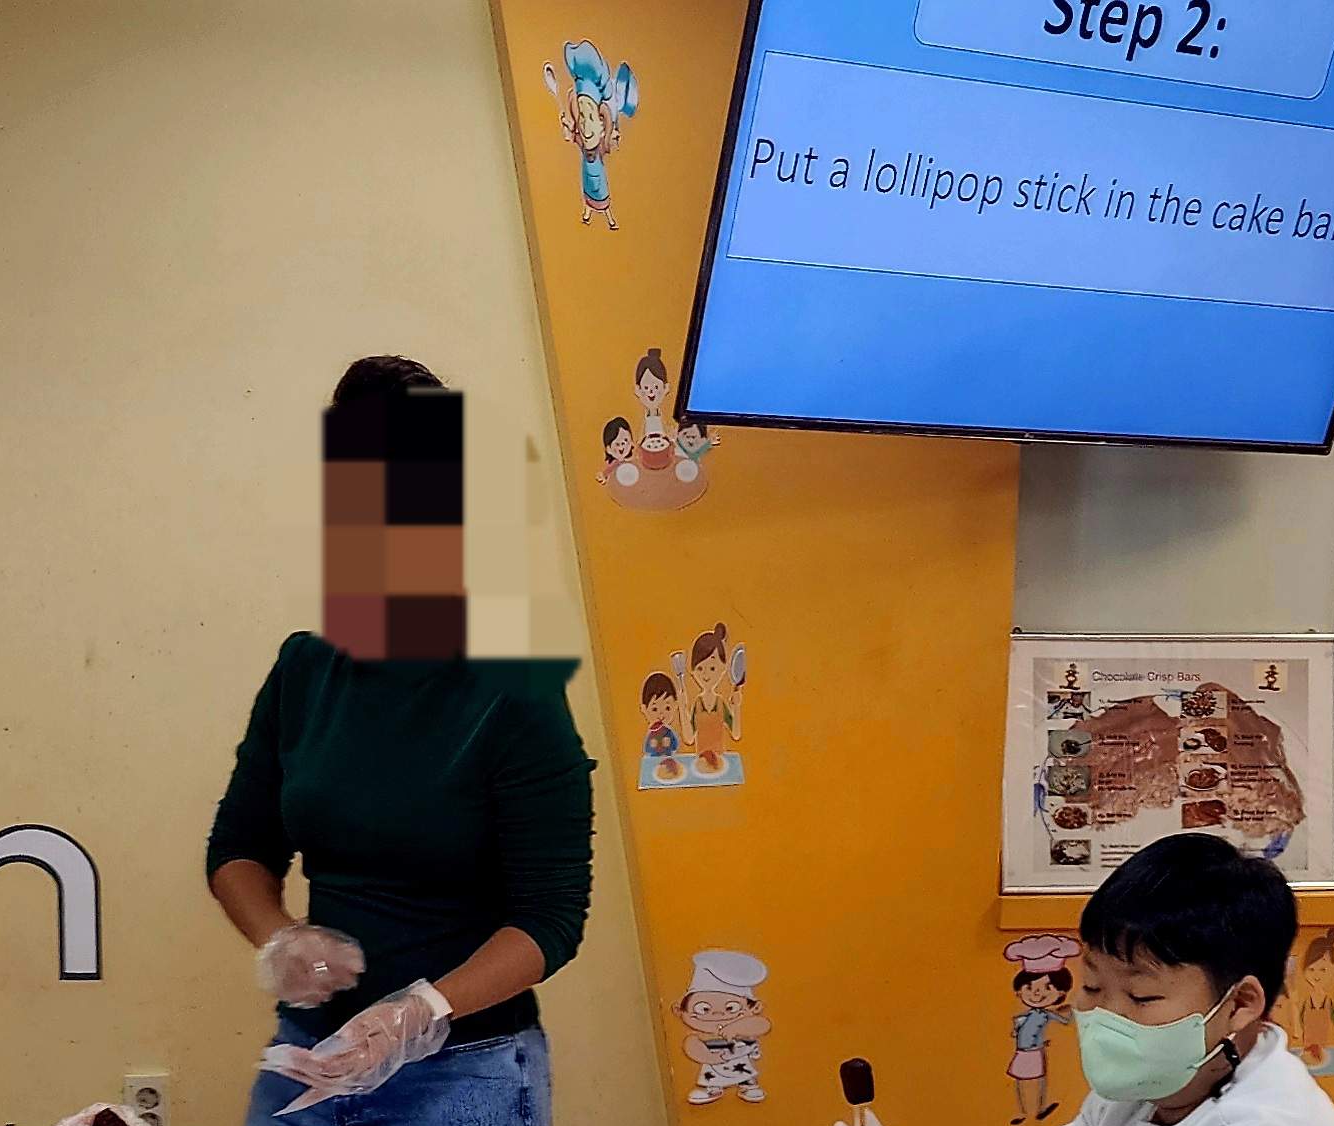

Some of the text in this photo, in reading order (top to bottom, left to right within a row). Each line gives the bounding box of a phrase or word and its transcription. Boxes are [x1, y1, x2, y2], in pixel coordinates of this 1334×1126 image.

[1043, 0, 1226, 61] Step 2:
[749, 137, 819, 189] Put
[828, 157, 849, 190] a
[863, 148, 1003, 214] lollipop
[1012, 168, 1095, 218] stick
[1104, 177, 1134, 221] in
[1147, 184, 1203, 228] the
[1212, 193, 1283, 237] cake
[1092, 671, 1201, 683] Chocolate Crisp Bars
